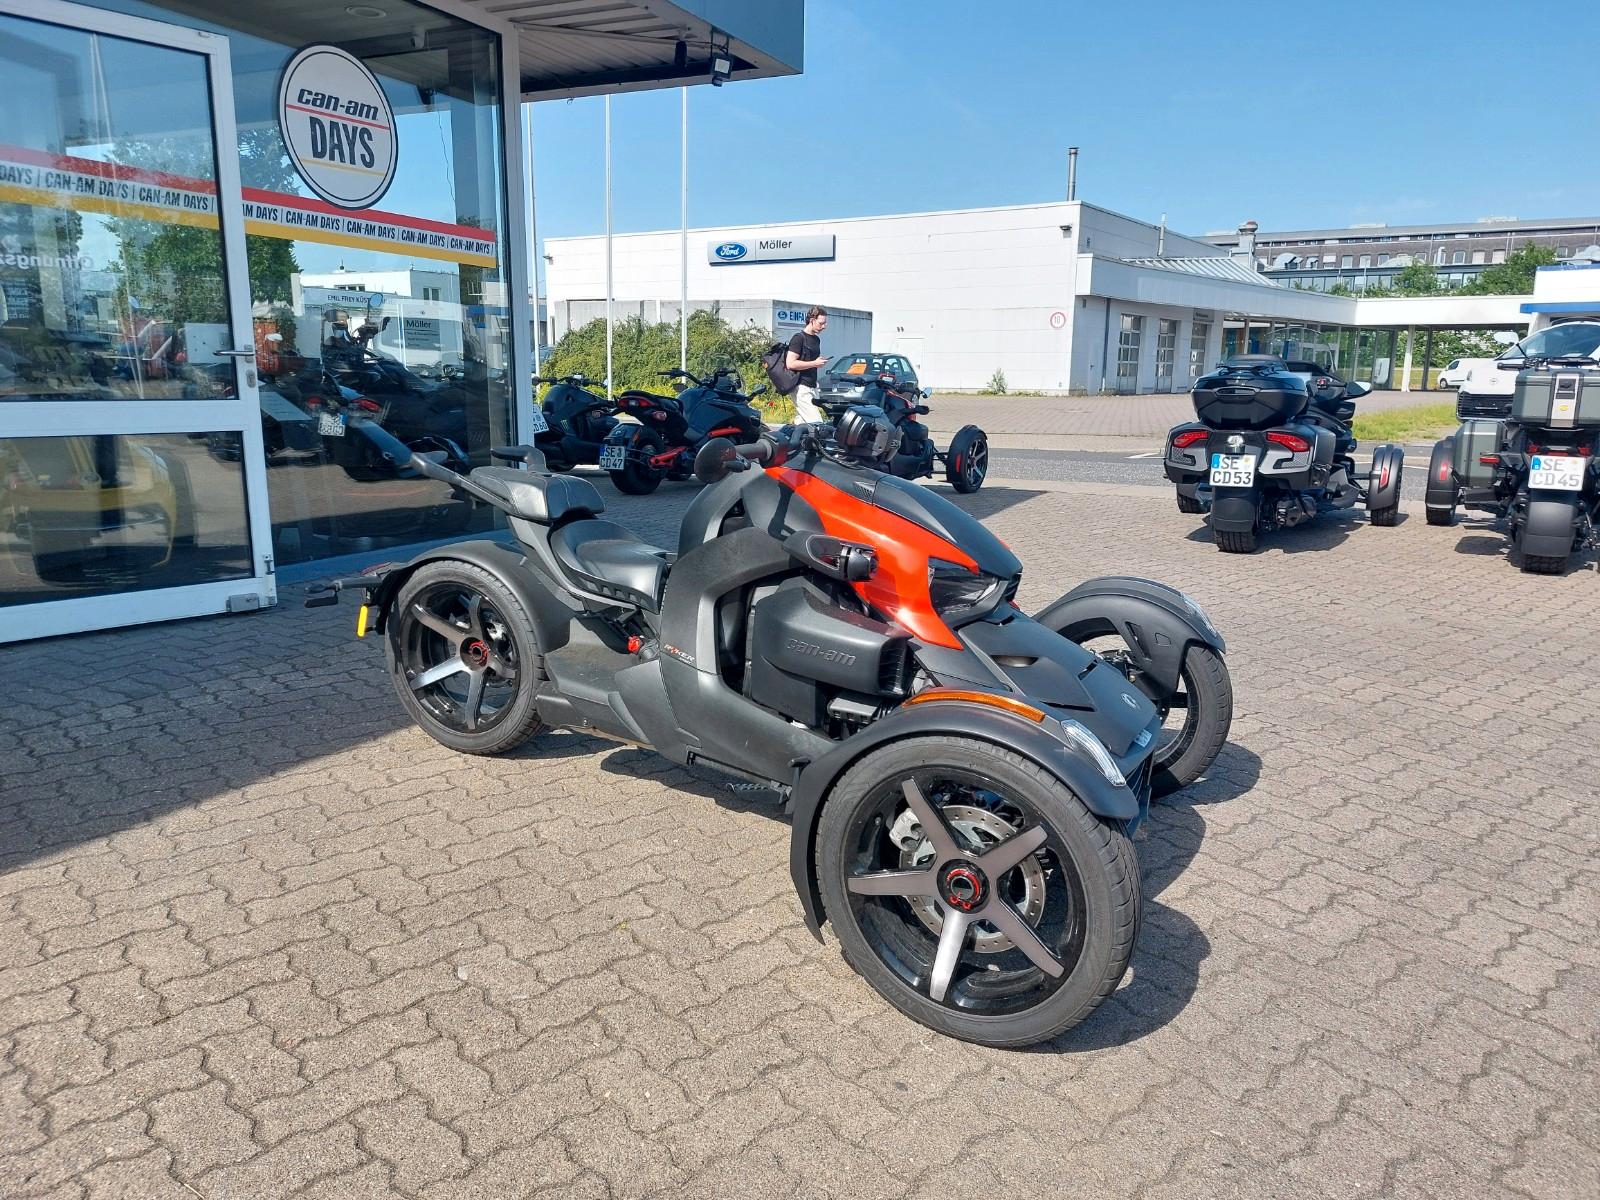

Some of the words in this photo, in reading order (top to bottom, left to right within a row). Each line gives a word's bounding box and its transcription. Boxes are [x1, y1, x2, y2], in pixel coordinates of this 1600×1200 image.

[297, 88, 379, 121] can-am
[309, 116, 375, 169] DAYS
[0, 164, 32, 185] DAYS
[45, 171, 95, 194] CAN-AM
[99, 180, 129, 199] DAYS
[139, 187, 181, 207] CAN-AM
[183, 194, 208, 210] DAYS
[256, 205, 278, 221] DAYS
[286, 210, 318, 228] CAN-AM
[320, 216, 340, 231] DAYS
[347, 220, 376, 236] CAN-AM
[378, 225, 395, 240] DAYS
[401, 229, 428, 244] CAN-AM
[429, 235, 445, 247] DAYS
[450, 237, 474, 252] CAN-AM
[475, 243, 490, 254] DAYS
[720, 243, 740, 256] Ford
[759, 239, 793, 250] Möller
[789, 310, 808, 323] EINFA
[406, 319, 432, 329] Möller
[604, 446, 616, 458] SE
[600, 458, 612, 468] CD
[612, 458, 623, 469] 47
[1221, 456, 1240, 470] SE
[1542, 458, 1566, 471] SE
[1212, 471, 1232, 484] CD
[1233, 471, 1252, 485] 53
[1531, 472, 1556, 486] CD
[1557, 473, 1581, 487] 45
[786, 638, 858, 667] can-am
